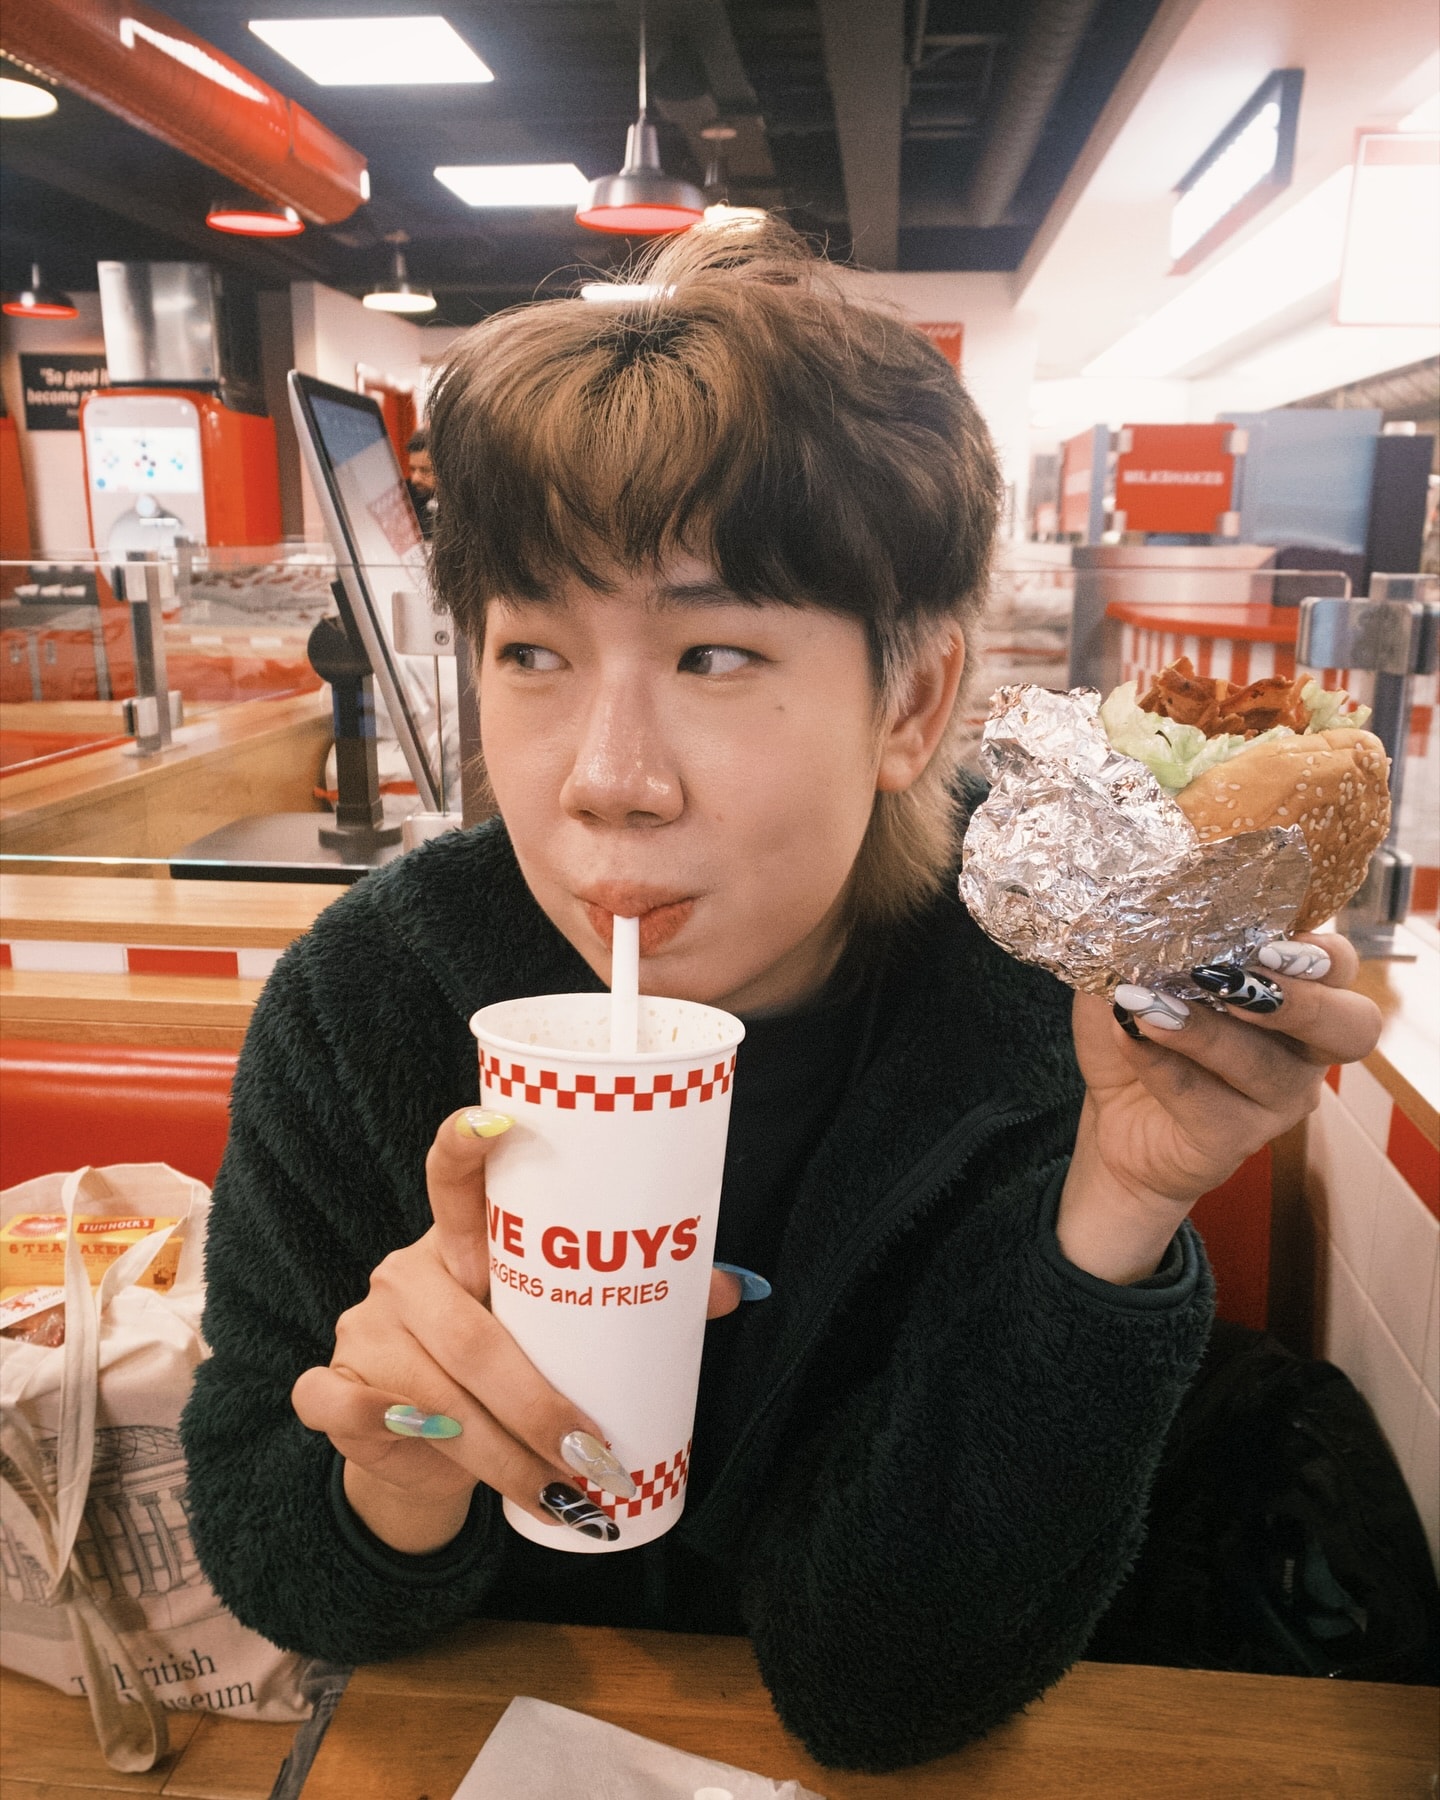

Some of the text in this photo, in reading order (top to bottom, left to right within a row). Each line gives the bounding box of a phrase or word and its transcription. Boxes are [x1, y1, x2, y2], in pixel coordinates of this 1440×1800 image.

[65, 369, 99, 389] good
[27, 389, 78, 404] become
[82, 1219, 150, 1232] TUNNOCK'S
[22, 1243, 129, 1256] TEAAKE
[550, 1286, 593, 1306] and
[601, 1280, 669, 1306] FRIES
